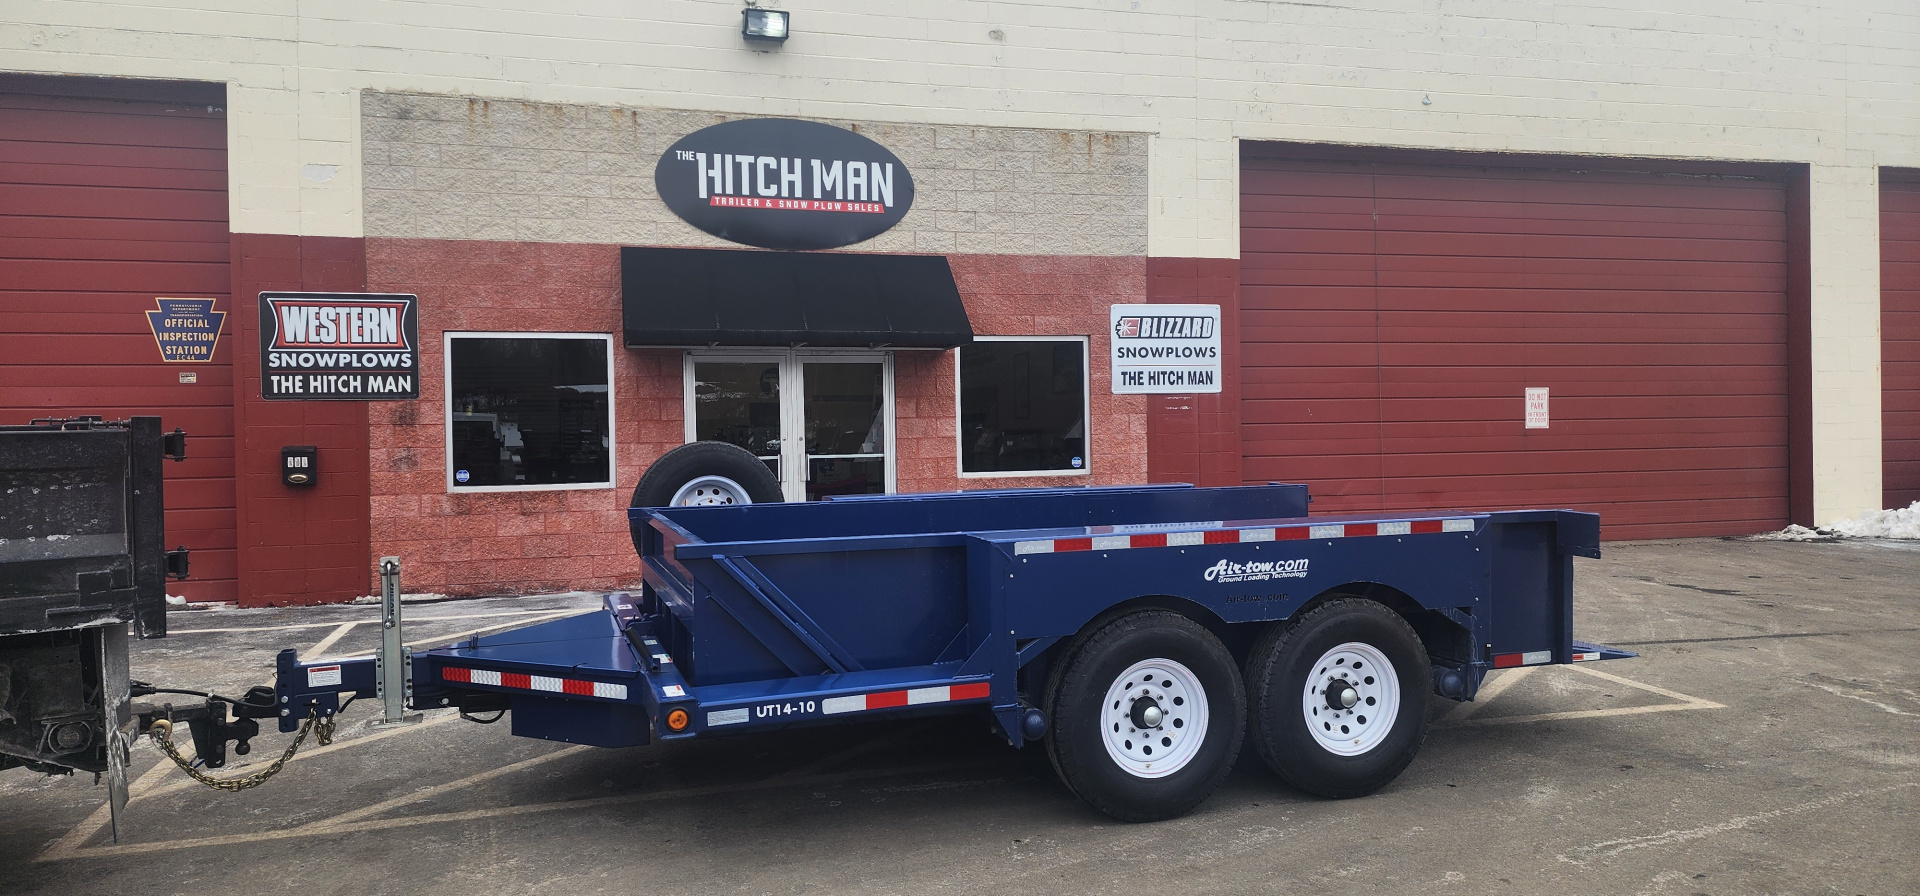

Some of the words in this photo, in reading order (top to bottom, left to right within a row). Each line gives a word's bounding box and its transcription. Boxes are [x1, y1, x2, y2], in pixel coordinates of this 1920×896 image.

[675, 149, 695, 161] THE
[696, 152, 803, 199] HITCH
[810, 158, 894, 208] MAN
[714, 196, 760, 207] TRAILER
[765, 200, 773, 208] &
[779, 200, 808, 209] SNOW
[814, 202, 842, 210] PLOW
[847, 203, 880, 212] SALES
[164, 318, 210, 328] OFFICIAL
[281, 306, 398, 344] WESTERN
[1140, 317, 1214, 338] BLIZZARD
[159, 332, 215, 341] INSPECTION
[165, 345, 207, 355] STATION
[1117, 346, 1217, 359] SNOWPLOWS
[268, 352, 412, 368] SNOWPLOWS
[270, 375, 304, 393] THE
[309, 374, 362, 393] HITCH
[367, 375, 412, 393] MAN
[1120, 371, 1145, 386] THE
[1148, 370, 1184, 386] HITCH
[1187, 370, 1214, 385] MAN
[1204, 558, 1309, 581] Air-tow.com
[1217, 576, 1242, 584] Ground
[1243, 573, 1270, 581] Loading
[1271, 571, 1308, 579] Technology
[756, 700, 816, 718] UT14-10
